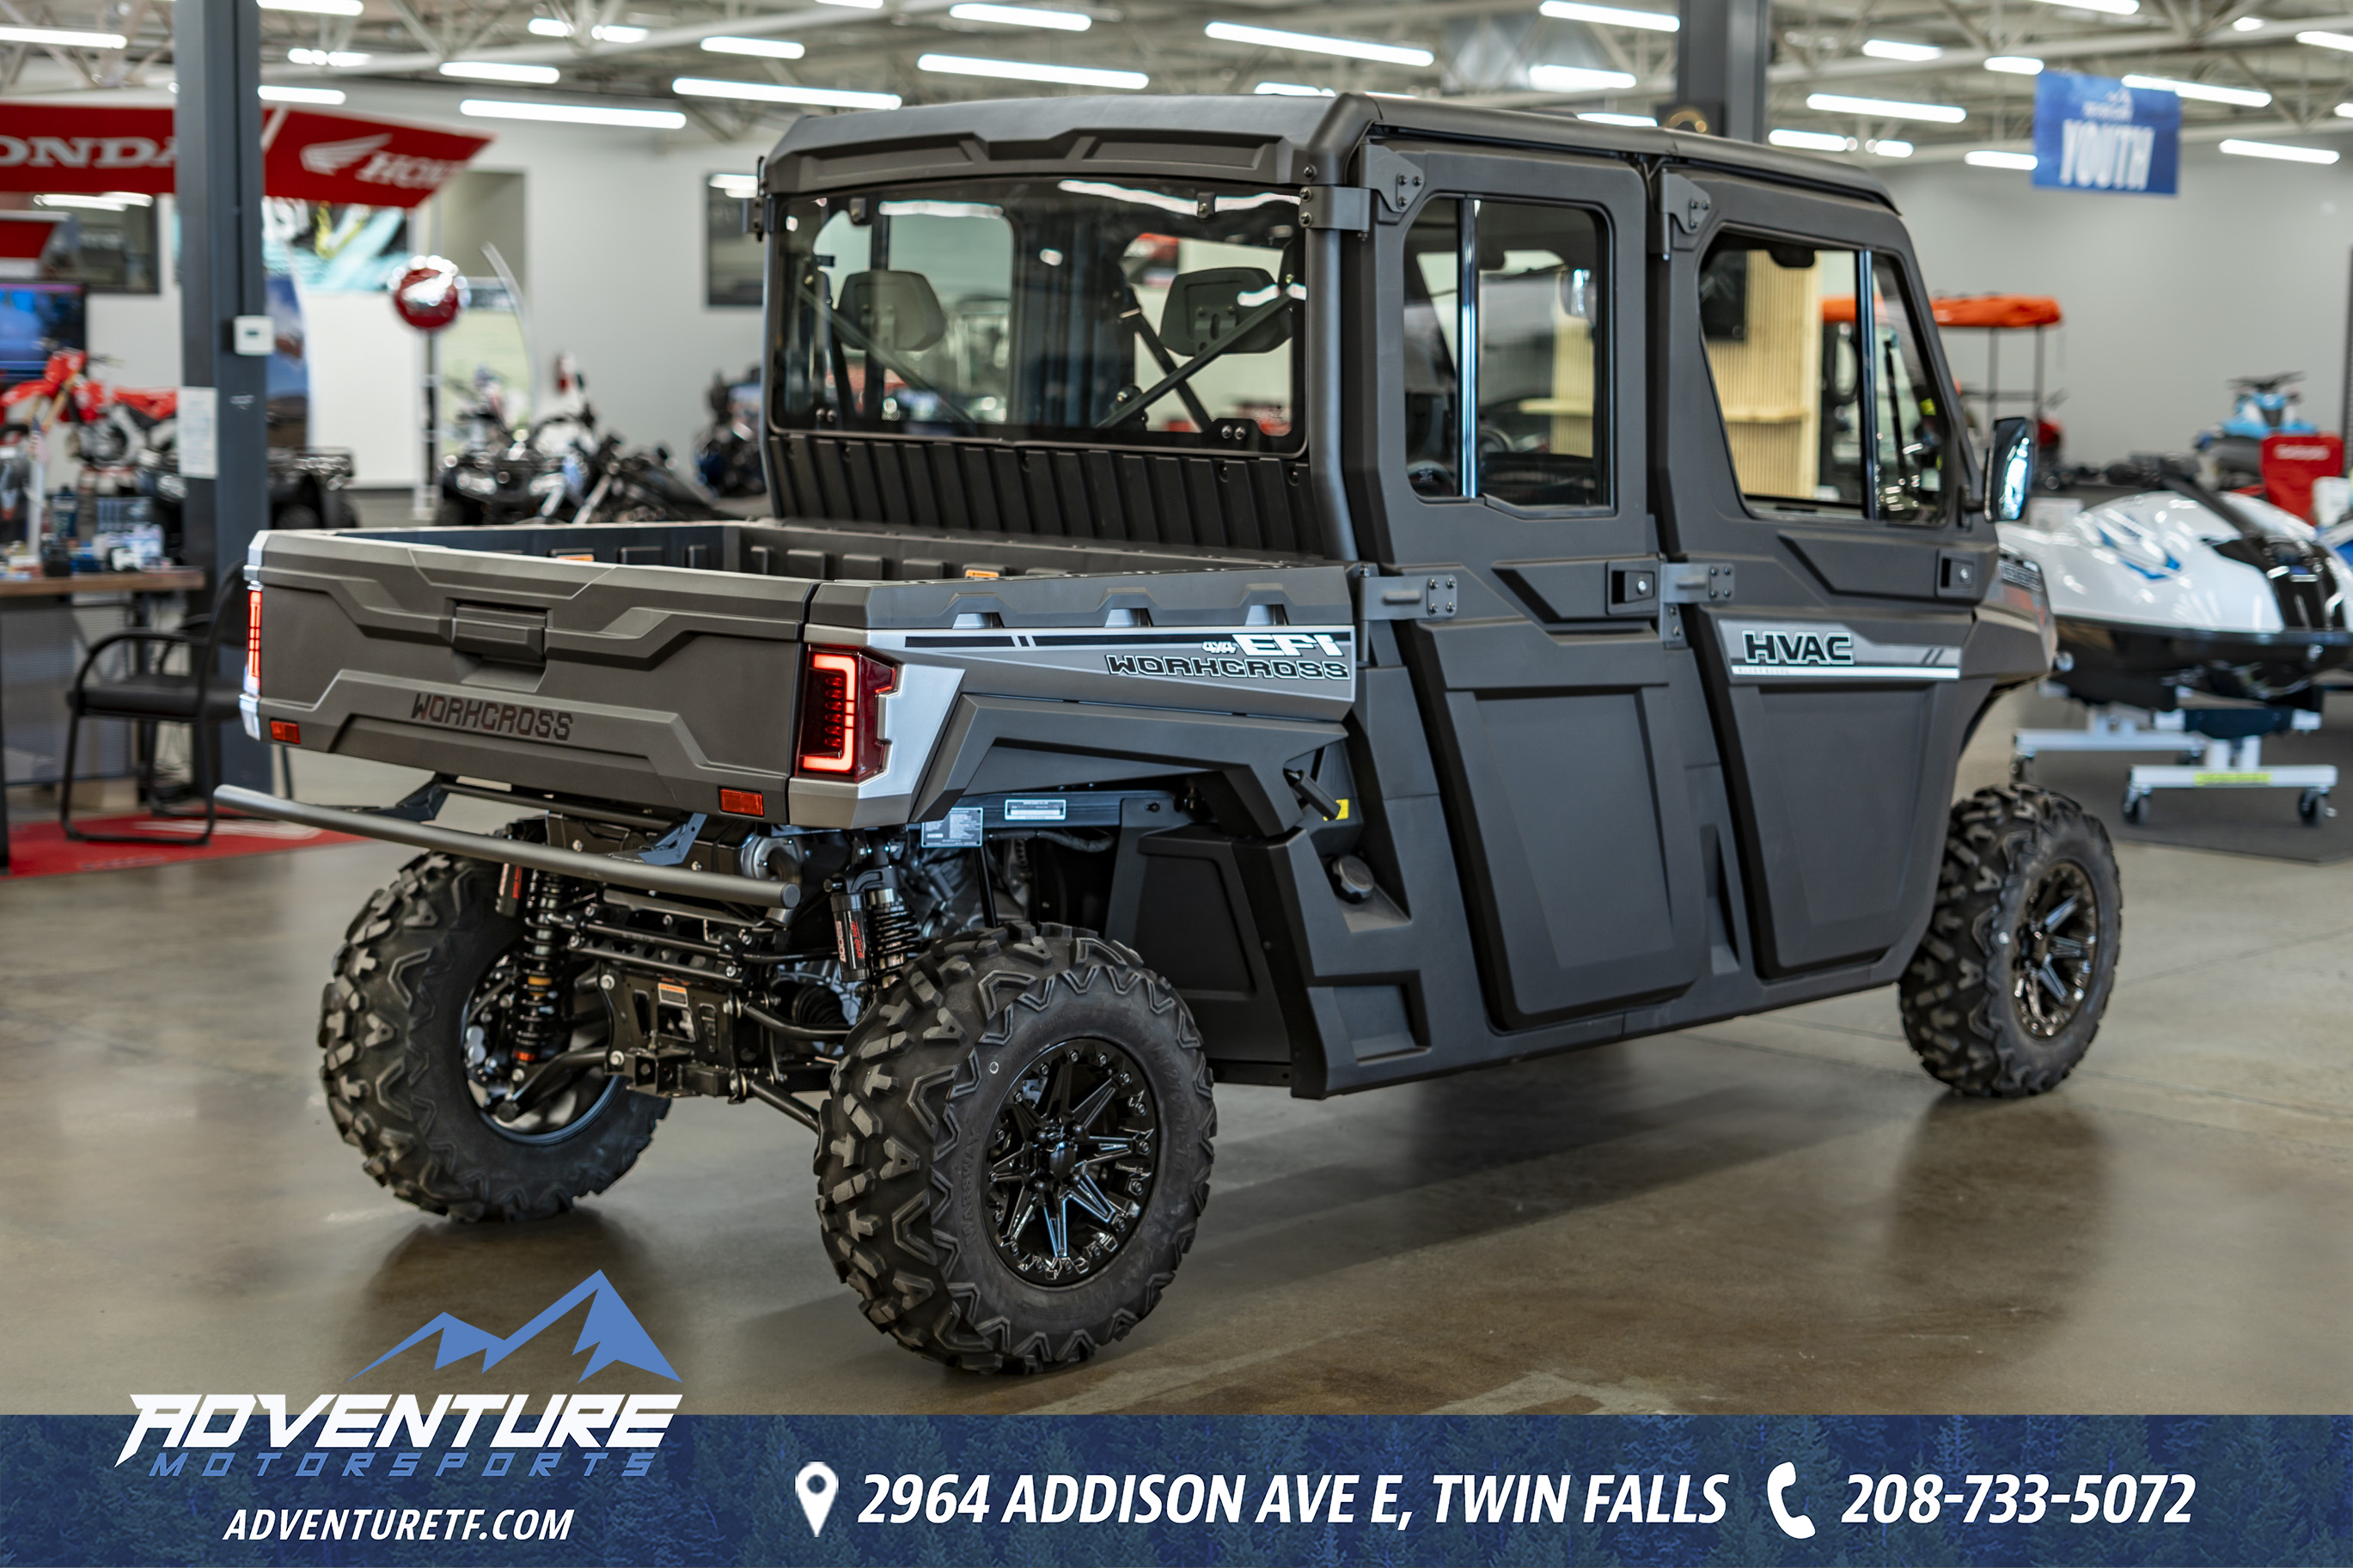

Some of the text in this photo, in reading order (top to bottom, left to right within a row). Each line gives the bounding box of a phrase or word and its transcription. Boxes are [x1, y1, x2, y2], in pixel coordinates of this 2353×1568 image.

[2059, 118, 2155, 191] YOUTH
[1232, 633, 1344, 656] EFI
[1741, 630, 1855, 665] HVAC
[1105, 654, 1351, 680] WORKCROSS
[410, 692, 573, 741] WORKCROSS
